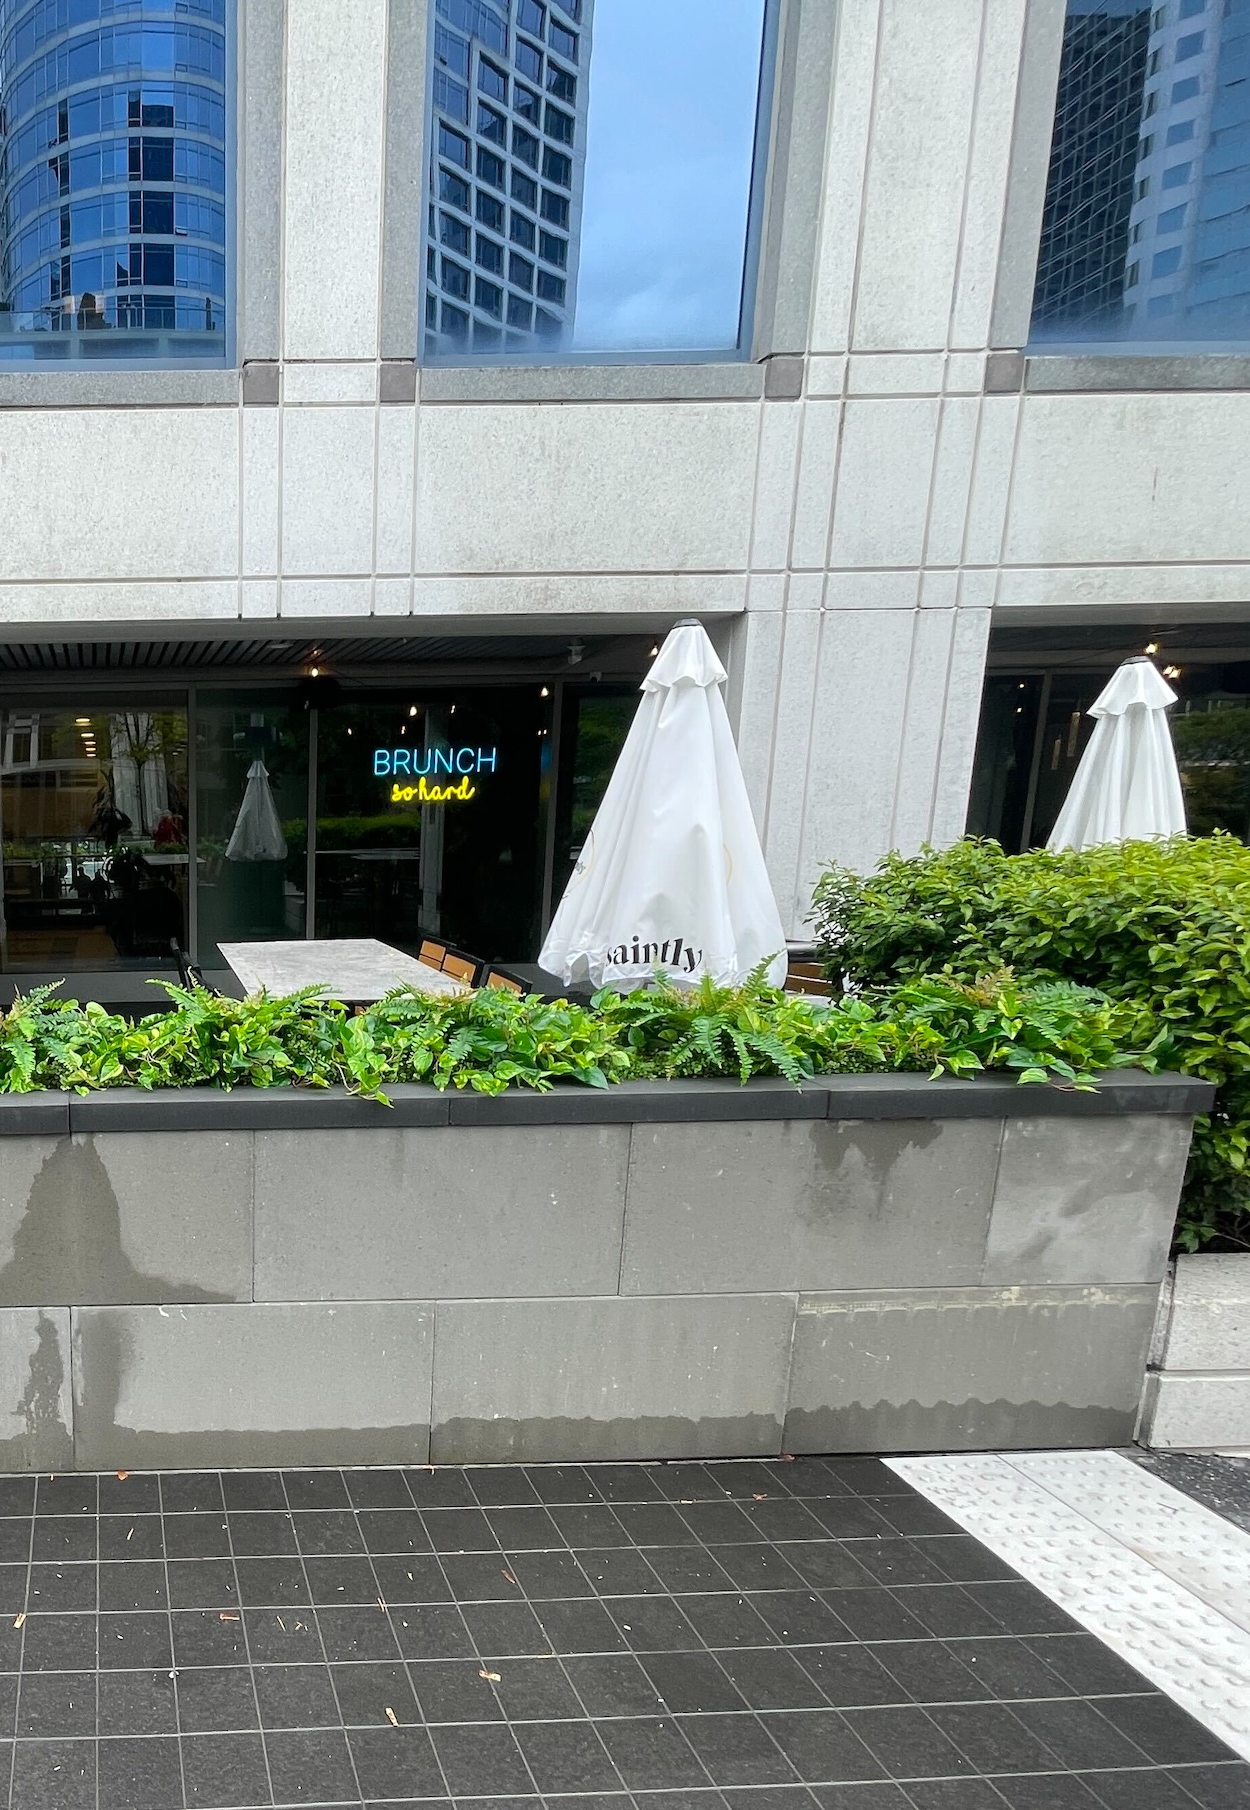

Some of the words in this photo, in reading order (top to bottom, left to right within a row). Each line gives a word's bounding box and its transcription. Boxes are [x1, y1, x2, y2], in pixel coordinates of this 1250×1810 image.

[374, 747, 497, 775] BRUNCH
[391, 783, 418, 802] so
[418, 775, 476, 801] hard
